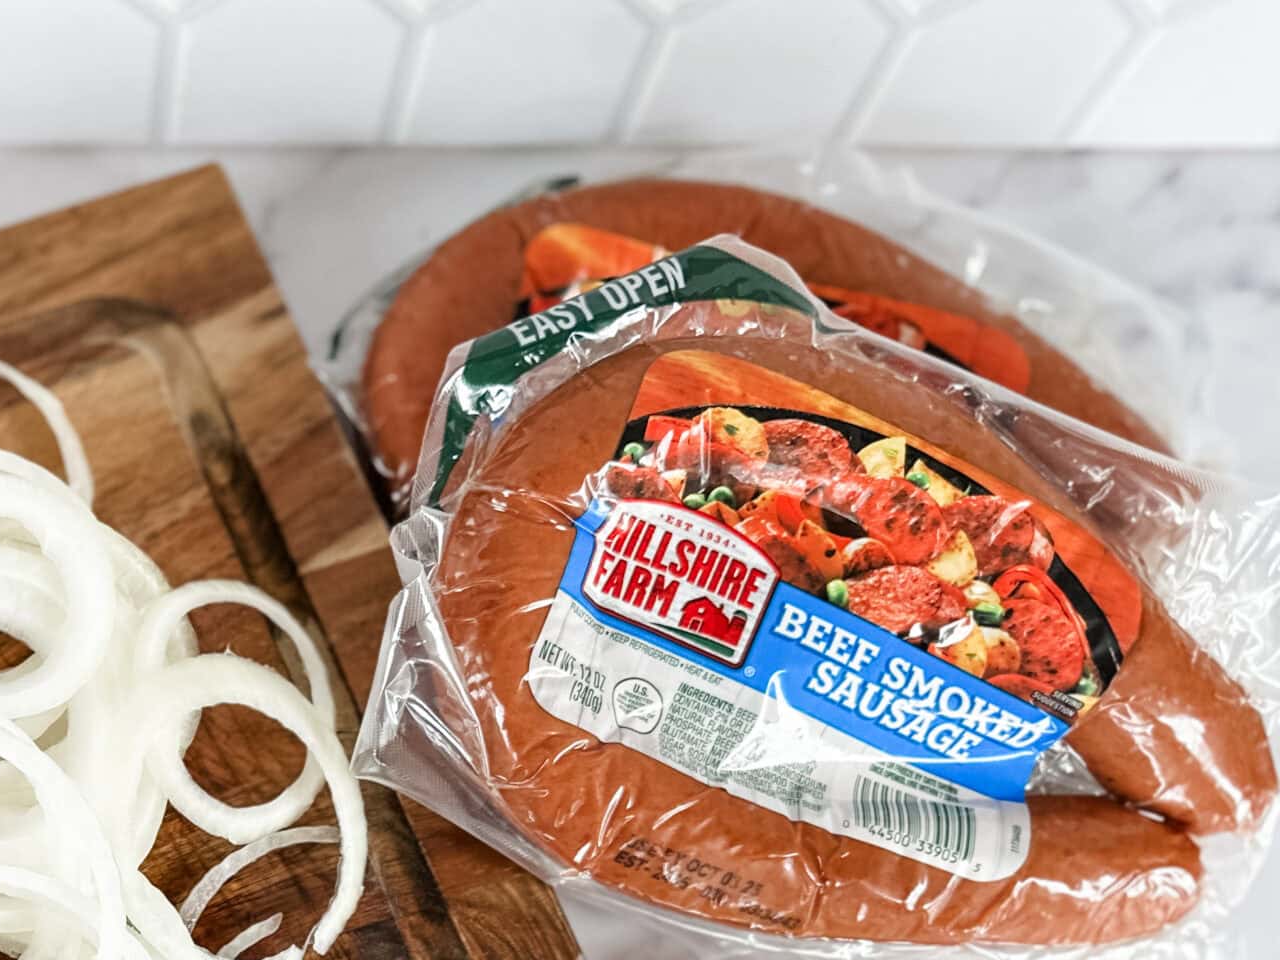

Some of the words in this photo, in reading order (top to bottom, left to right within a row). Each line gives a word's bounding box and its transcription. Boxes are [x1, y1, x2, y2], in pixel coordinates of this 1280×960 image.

[507, 295, 594, 346] EASY
[599, 257, 686, 311] OPEN
[604, 512, 767, 610] HILLSHIRE
[666, 514, 694, 533] EST
[699, 528, 731, 549] 1934
[593, 550, 680, 619] FARM
[538, 640, 563, 665] NET
[774, 603, 880, 673] BEEF
[881, 656, 1045, 749] SMOKED
[668, 703, 706, 727] NATURAL
[808, 660, 983, 760] SAUSAGE
[686, 858, 720, 879] OCT
[843, 819, 850, 829] 0
[869, 824, 911, 848] 44500
[915, 840, 959, 864] 33905
[973, 863, 982, 873] 5
